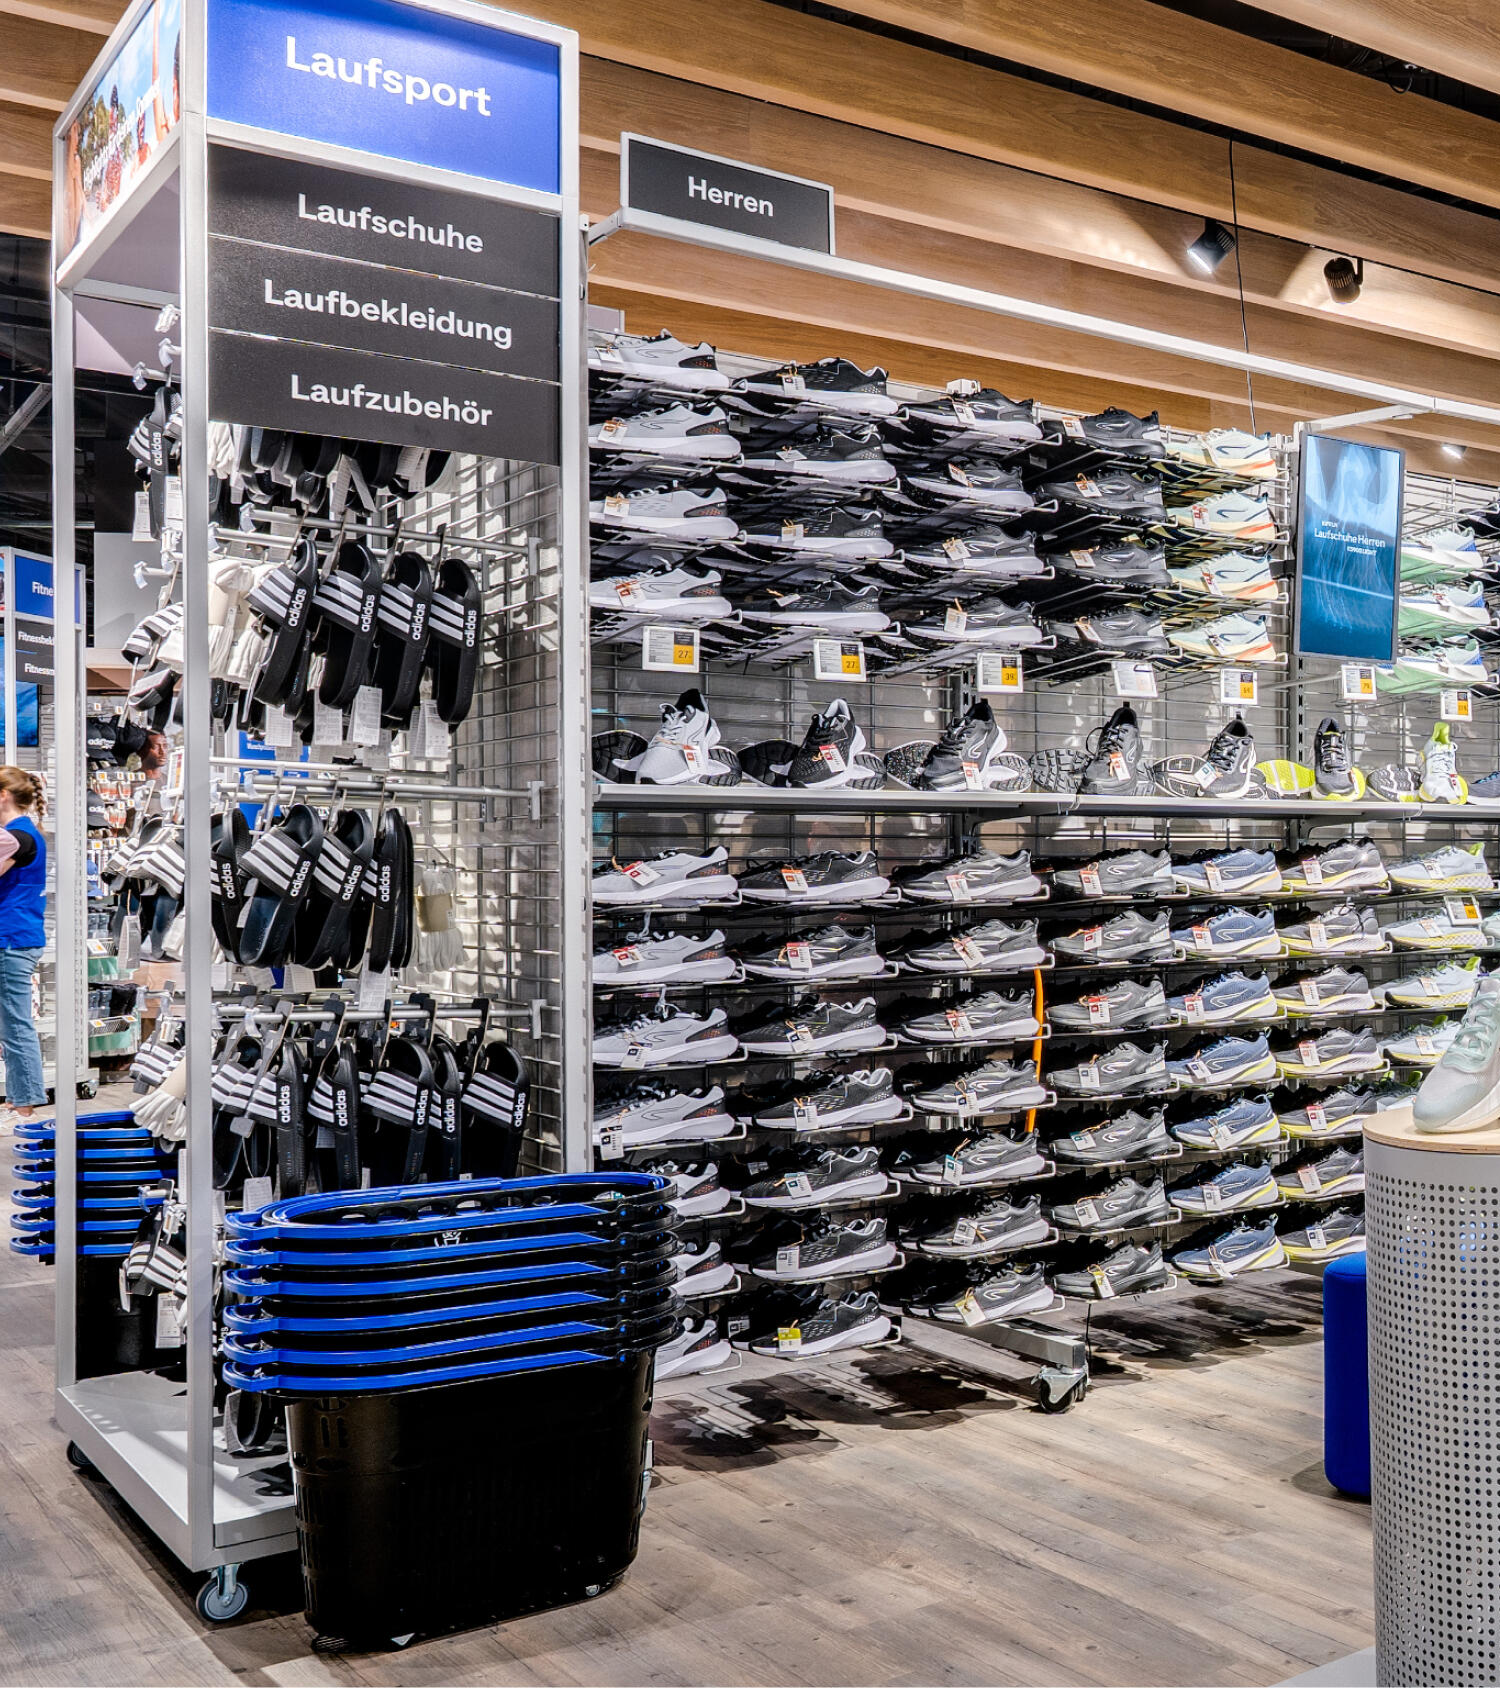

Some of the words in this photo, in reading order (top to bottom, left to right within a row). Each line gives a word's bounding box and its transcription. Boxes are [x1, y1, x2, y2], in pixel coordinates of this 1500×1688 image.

[286, 35, 492, 117] Laufsport
[688, 176, 774, 217] Herren
[298, 193, 485, 253] Laufschuhe
[264, 278, 512, 350] Laufbekleidung
[291, 374, 493, 426] Laufzubehör
[1314, 528, 1357, 543] Laufschuhe
[1358, 535, 1386, 548] Herren
[288, 588, 307, 627] adidas
[361, 594, 375, 633] adidas
[412, 603, 426, 640] adidas
[466, 609, 478, 648] adidas
[222, 862, 236, 899] adidas
[290, 860, 311, 897] adidas
[342, 864, 362, 901] adidas
[380, 865, 391, 903] adidas
[280, 1085, 291, 1124] adidas
[335, 1089, 348, 1127] adidas
[416, 1089, 429, 1126] adidas
[443, 1097, 455, 1133] adidas
[514, 1092, 527, 1128] adidas
